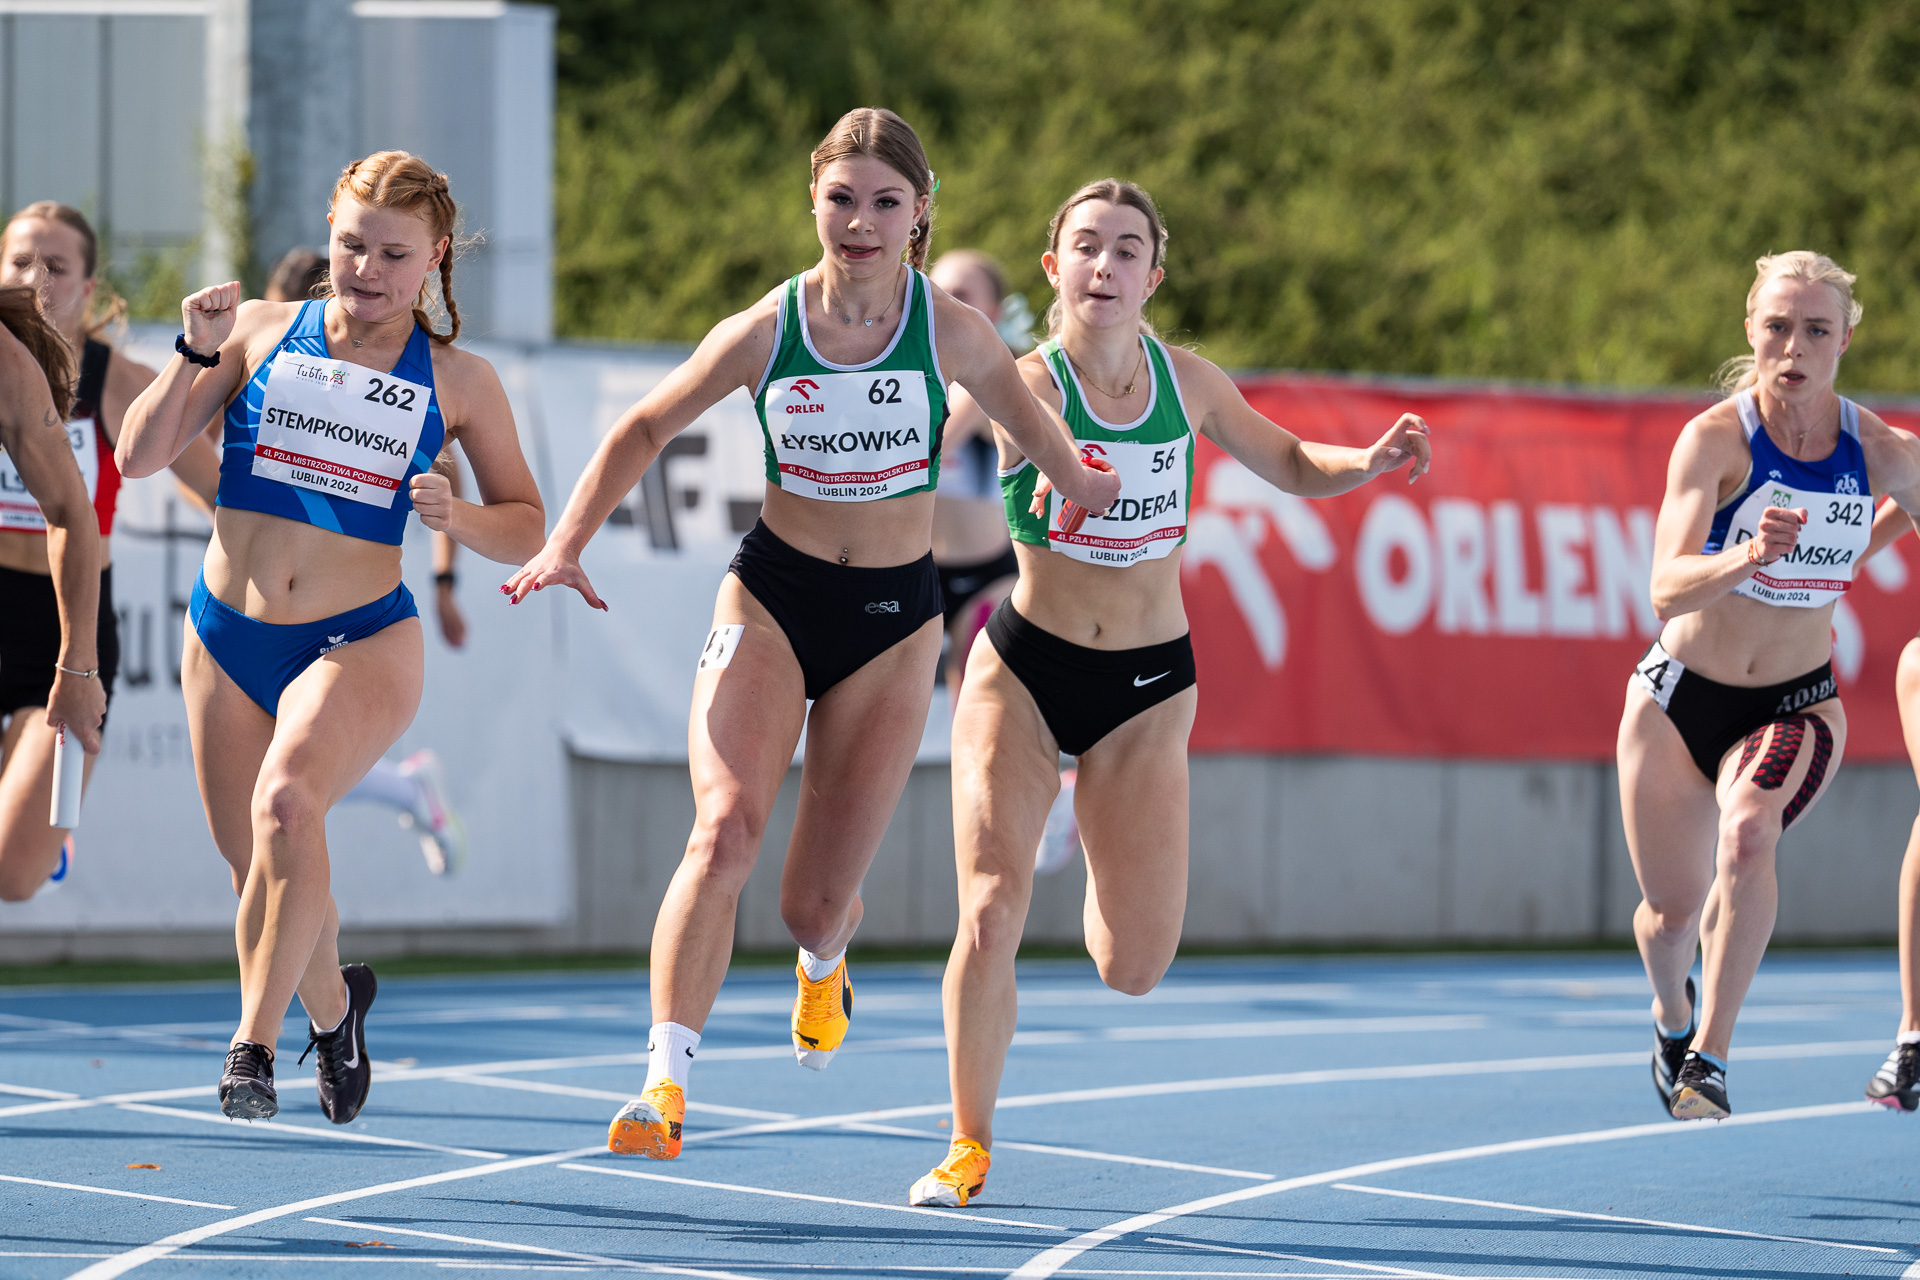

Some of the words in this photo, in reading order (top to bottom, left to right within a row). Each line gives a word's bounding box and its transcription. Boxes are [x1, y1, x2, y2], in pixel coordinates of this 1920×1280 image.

[364, 377, 416, 412] 262
[868, 378, 902, 405] 62
[785, 403, 825, 414] ORLEN
[265, 407, 408, 459] STEMPKOWSKA
[781, 427, 921, 455] ŁYSKOWKA
[262, 449, 273, 458] 41.
[273, 450, 291, 463] PZLA
[292, 455, 351, 477] MISTRZOSTWA
[352, 471, 379, 484] POLSKI
[378, 477, 394, 488] U23
[787, 465, 798, 474] 41.
[798, 468, 815, 480] PZLA
[816, 472, 876, 483] MISTRZOSTWA
[877, 467, 904, 480] POLSKI
[904, 462, 921, 472] U23
[1150, 446, 1177, 474] 56
[290, 470, 329, 487] LUBLIN
[330, 479, 359, 495] 2024
[817, 485, 857, 497] LUBLIN
[859, 483, 888, 496] 2024
[1061, 489, 1178, 522] ZDERA
[1825, 501, 1863, 526] 342
[1056, 534, 1068, 542] 41.
[1068, 535, 1088, 544] PZLA
[1089, 538, 1144, 549] MISTRZOSTWA
[1144, 531, 1163, 543] POLSKI
[1164, 528, 1180, 538] U23
[1090, 550, 1129, 562] LUBLIN
[1129, 546, 1148, 561] 2024
[1355, 494, 1665, 638] ORLEN
[1751, 584, 1787, 601] LUBLIN
[1787, 592, 1810, 601] 2024
[1755, 572, 1803, 589] MISTRZOSTWA
[1803, 580, 1828, 589] POLSKI
[1828, 581, 1844, 590] U23
[864, 600, 901, 614] esa
[1644, 659, 1670, 693] 4
